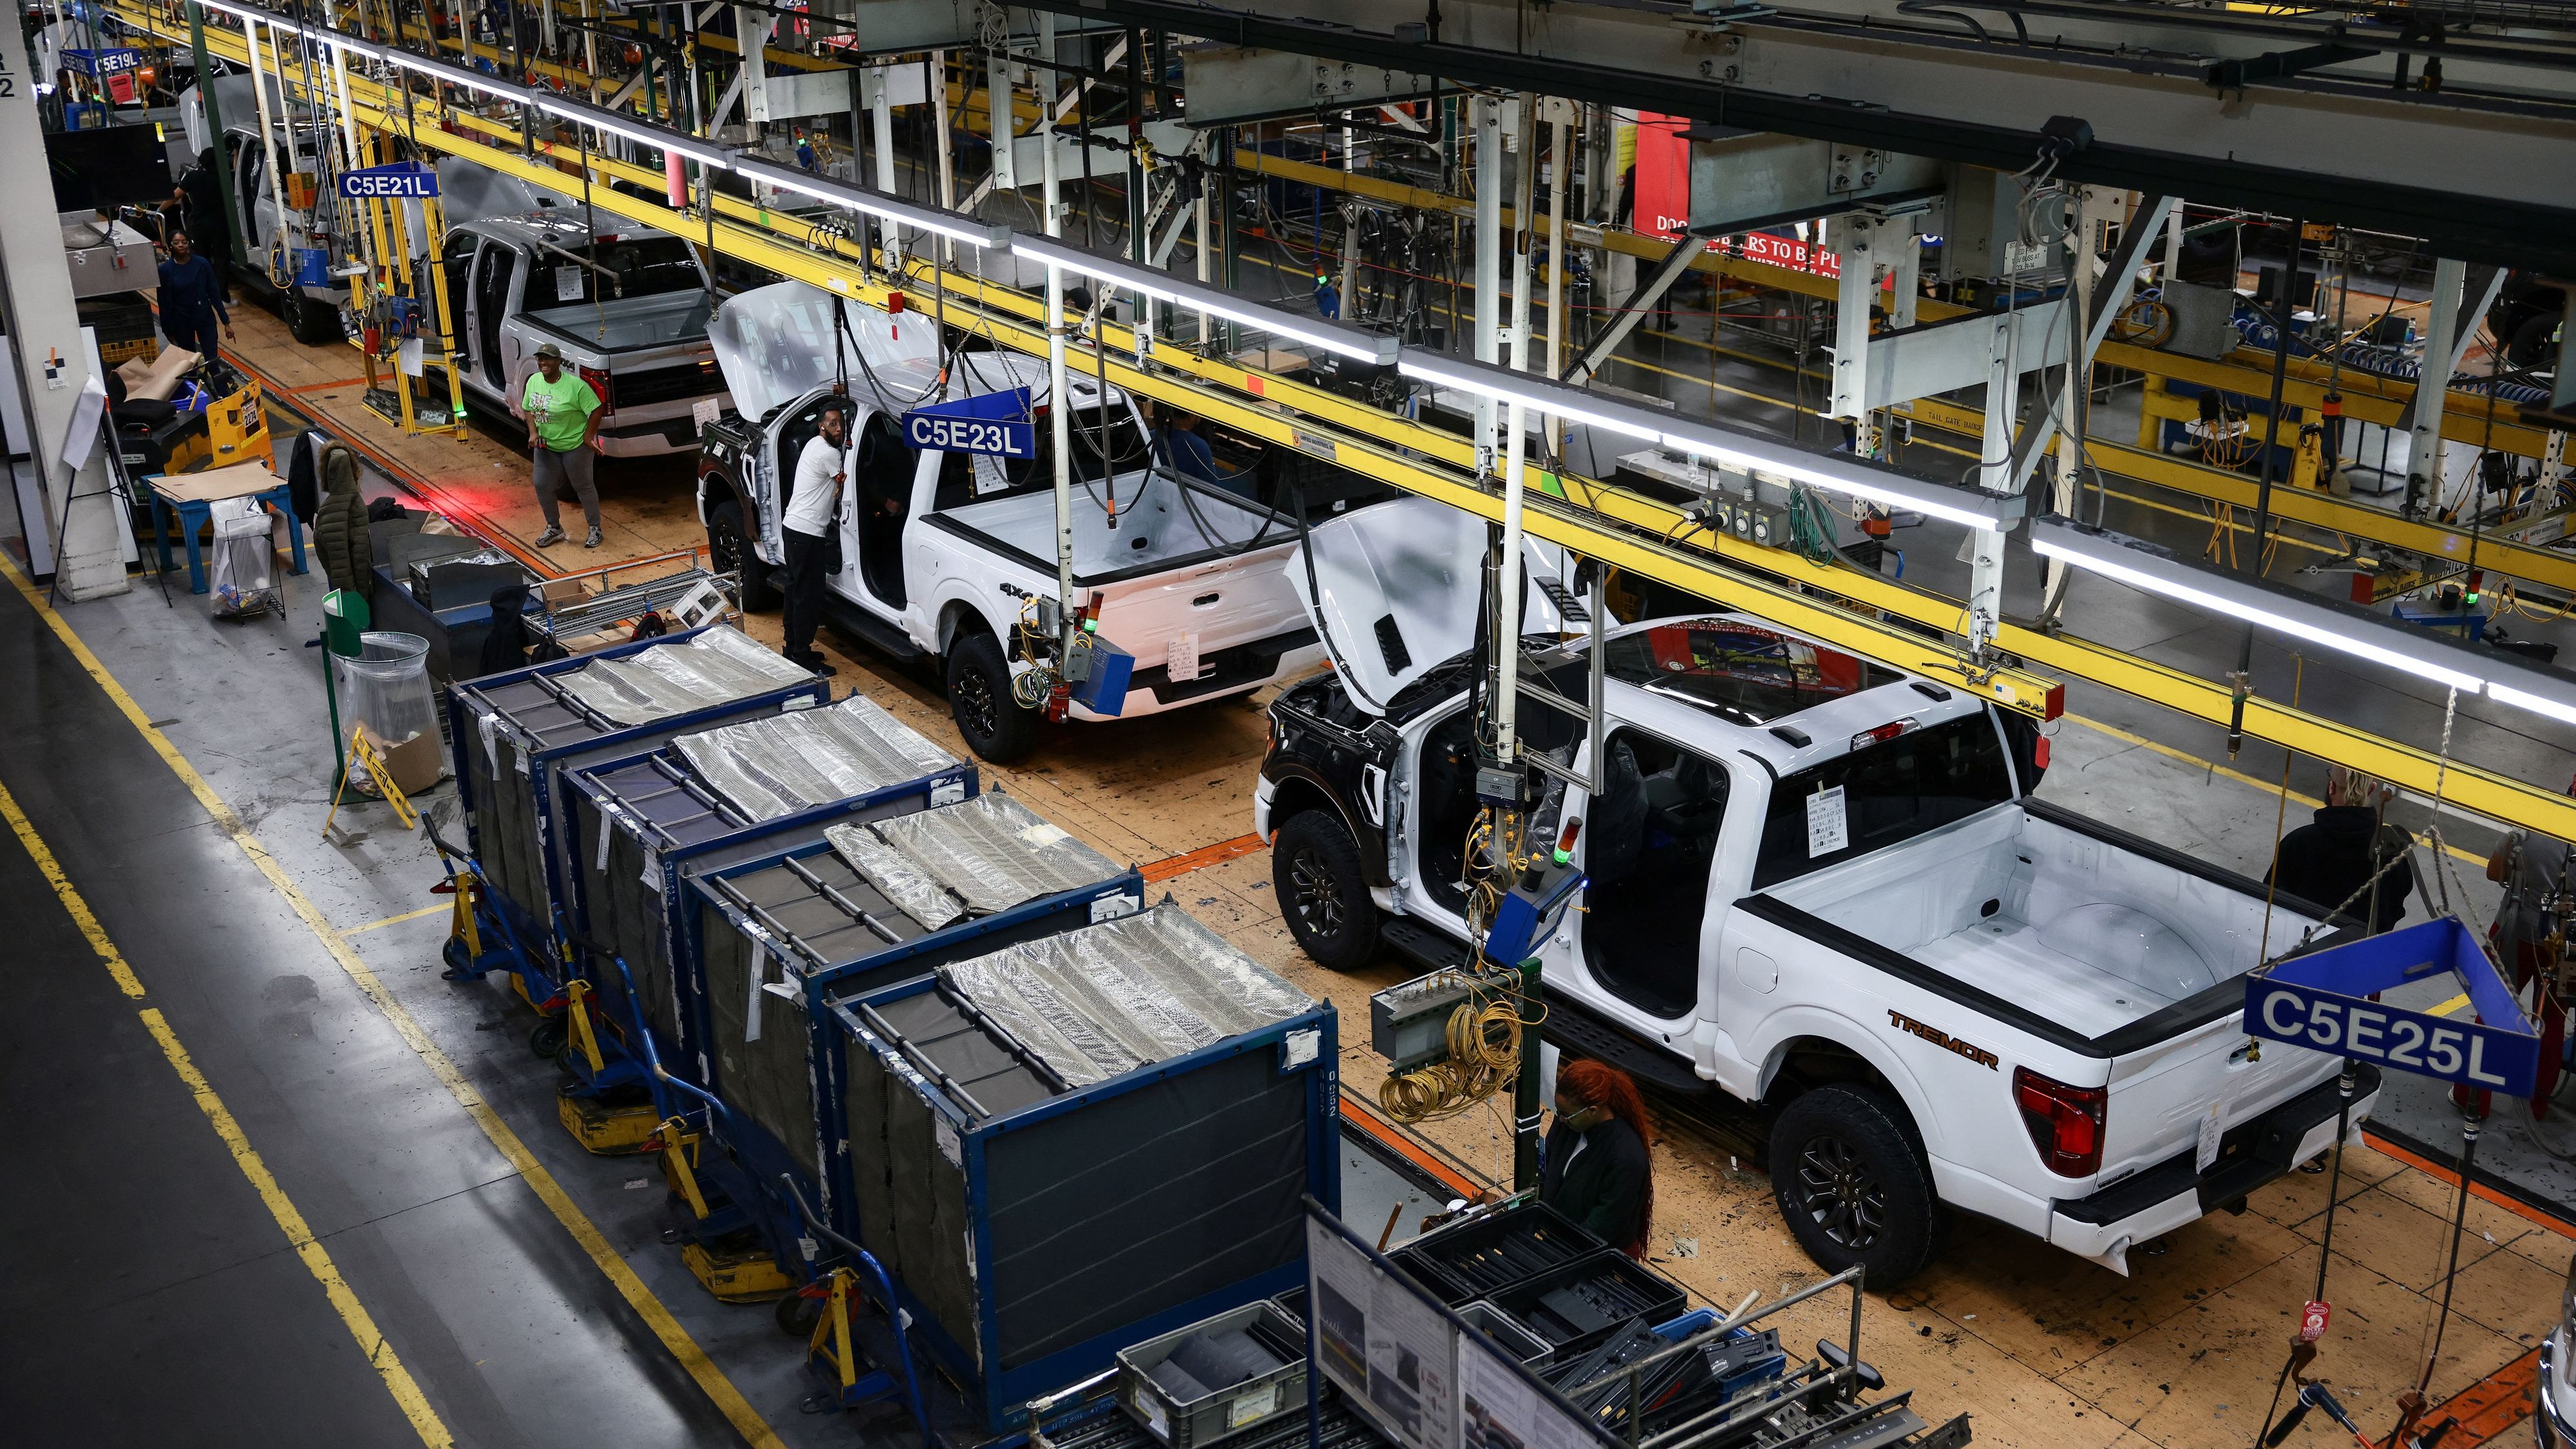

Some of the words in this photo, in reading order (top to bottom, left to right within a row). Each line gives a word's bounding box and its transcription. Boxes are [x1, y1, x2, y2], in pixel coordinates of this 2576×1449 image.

[62, 53, 90, 73] C5E19L
[346, 176, 430, 195] C5E21L
[1771, 240, 1791, 258] TO
[245, 410, 256, 426] 2274
[1928, 412, 1942, 422] TAIL
[1946, 416, 1961, 426] GATE
[911, 417, 1022, 454] C5E23L
[1887, 1009, 1999, 1072] TREMOR
[2262, 990, 2506, 1086] C5E25L
